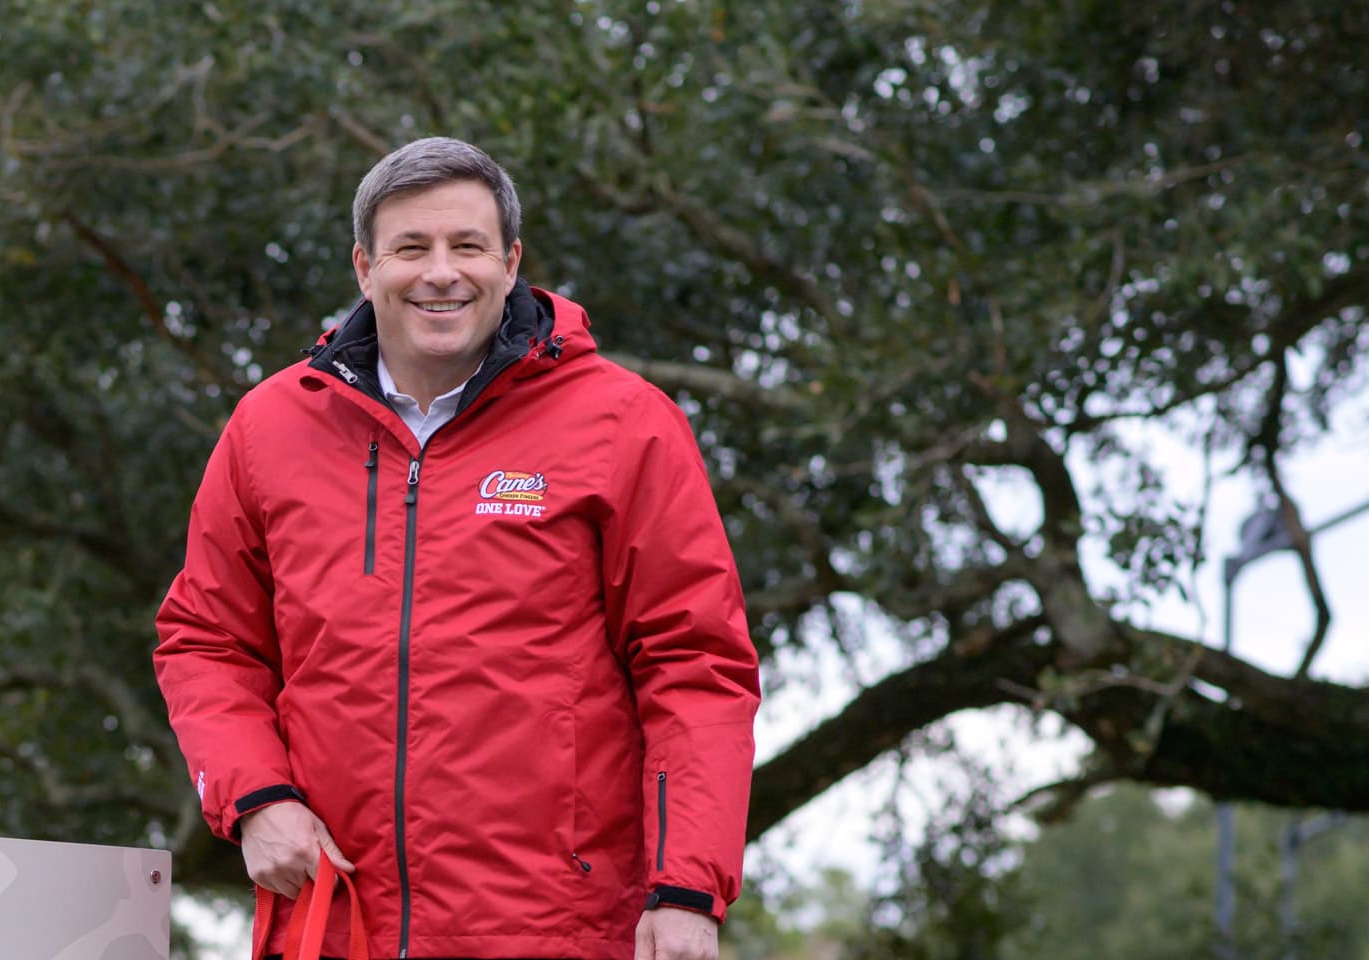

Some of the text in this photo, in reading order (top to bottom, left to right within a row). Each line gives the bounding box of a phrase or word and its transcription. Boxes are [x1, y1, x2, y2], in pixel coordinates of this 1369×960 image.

[480, 470, 548, 499] Cane's
[475, 502, 542, 517] ONE LOVE
